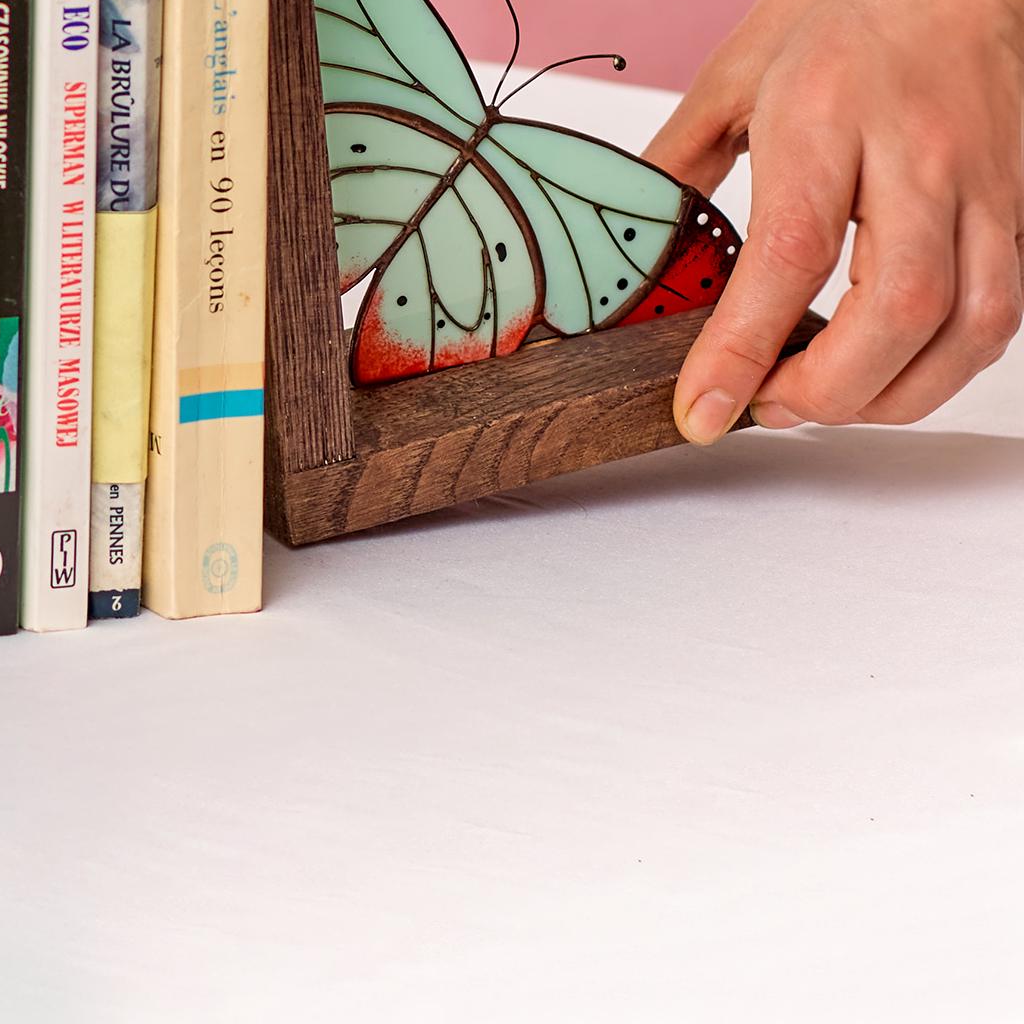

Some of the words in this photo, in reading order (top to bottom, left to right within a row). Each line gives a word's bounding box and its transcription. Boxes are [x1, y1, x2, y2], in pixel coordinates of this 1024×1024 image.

[61, 6, 91, 52] ECO
[110, 19, 133, 53] LA
[61, 81, 88, 187] SUPERMAN
[109, 58, 137, 173] BRÛLURE
[210, 130, 226, 164] en
[62, 199, 85, 216] W
[209, 178, 235, 214] 90
[58, 220, 84, 349] LITERATURZE
[204, 230, 235, 315] leçons
[55, 358, 81, 449] MASOWEJ
[109, 506, 124, 566] PENNES
